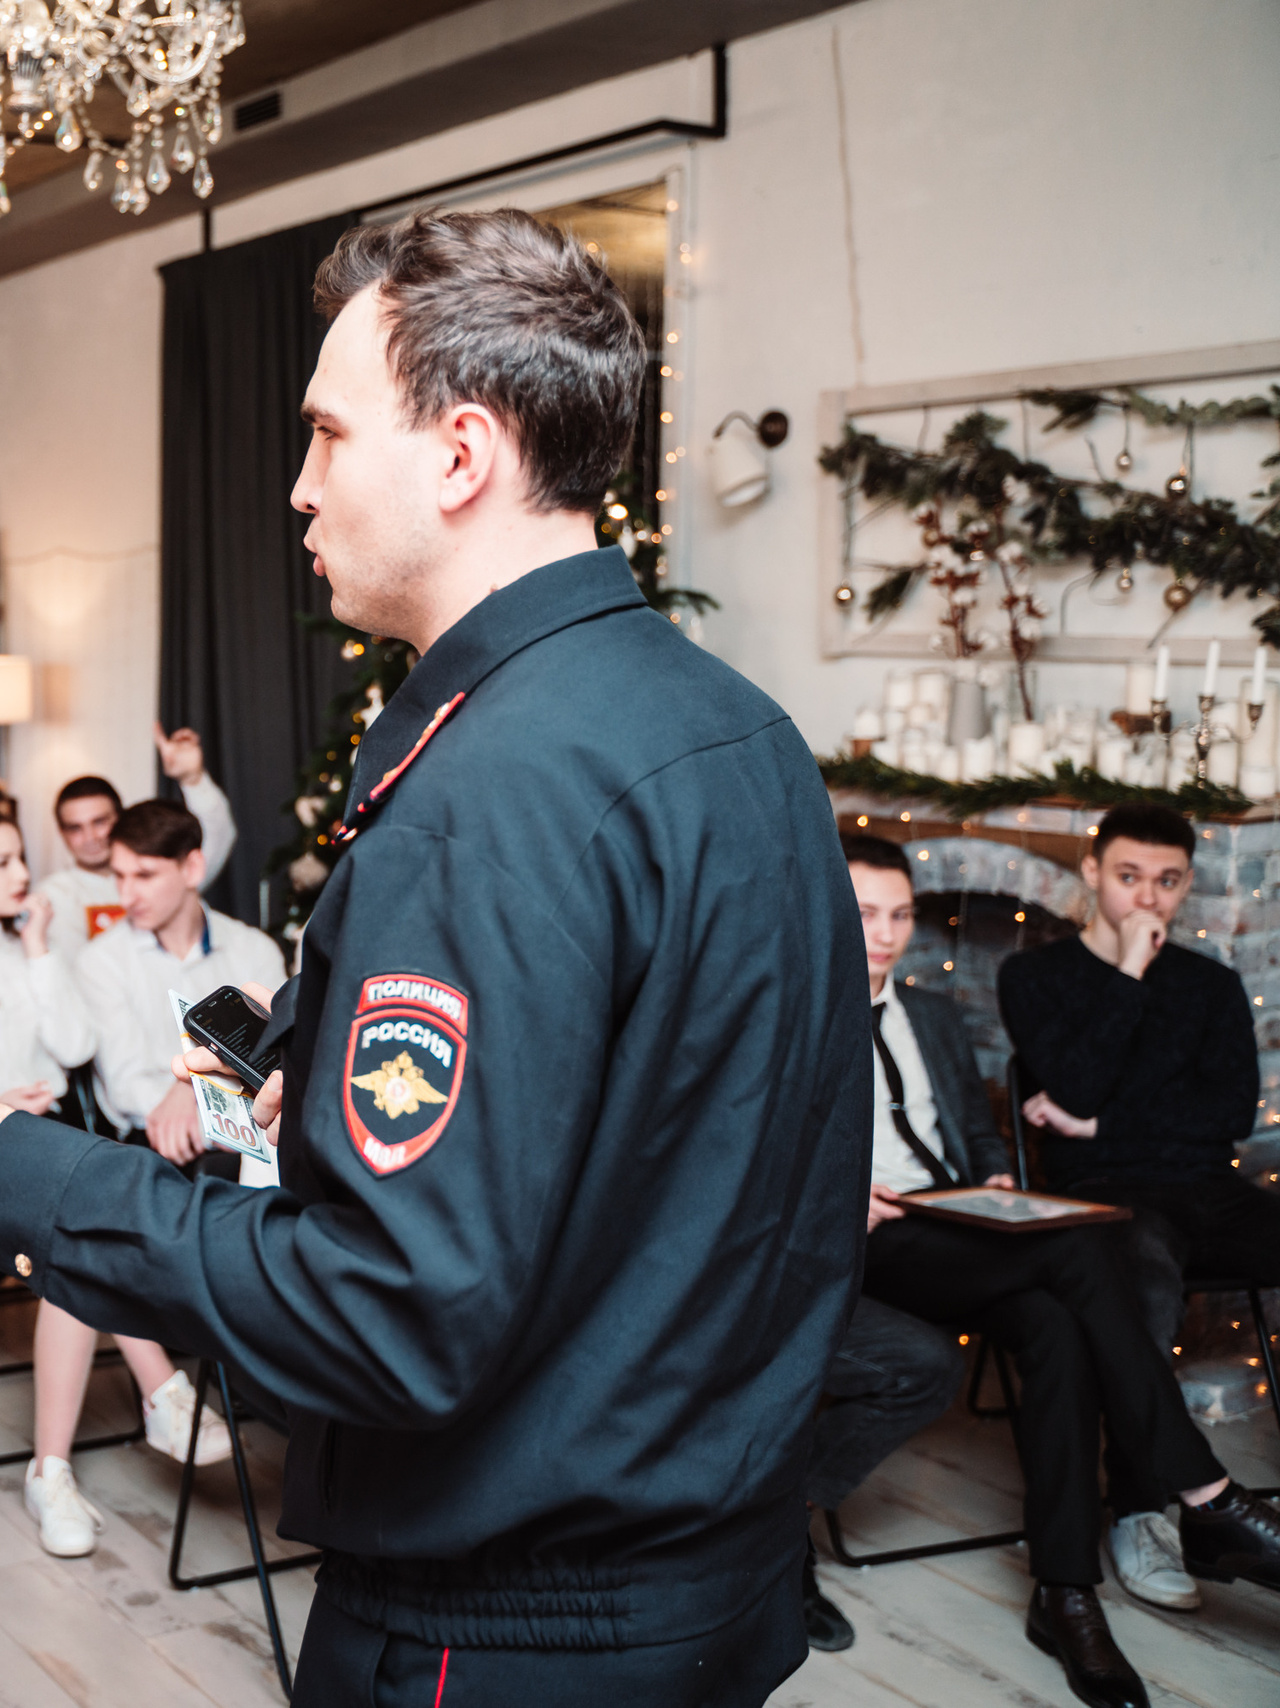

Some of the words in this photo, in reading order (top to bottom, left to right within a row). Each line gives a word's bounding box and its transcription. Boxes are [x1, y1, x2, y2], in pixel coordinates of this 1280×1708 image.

[368, 979, 463, 1020] ПОЛИЦИЯ
[361, 1021, 453, 1068] РОССИЯ
[212, 1113, 257, 1147] 100
